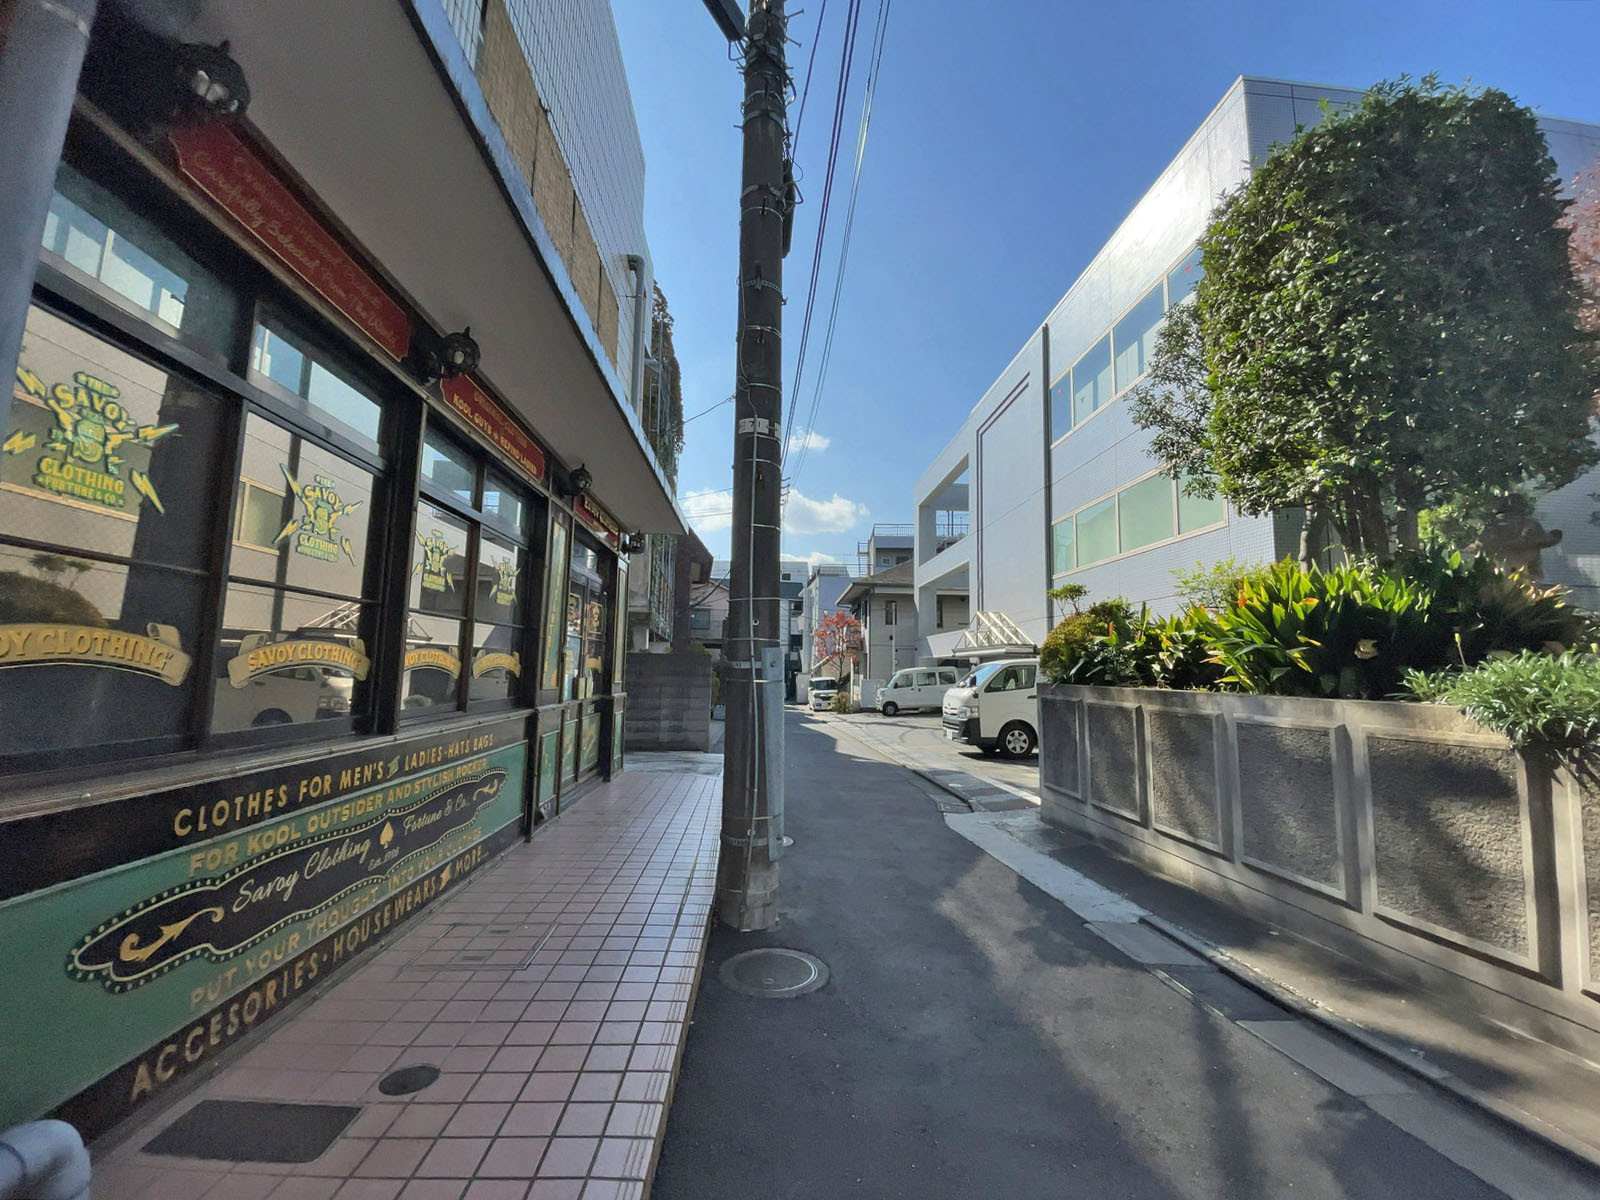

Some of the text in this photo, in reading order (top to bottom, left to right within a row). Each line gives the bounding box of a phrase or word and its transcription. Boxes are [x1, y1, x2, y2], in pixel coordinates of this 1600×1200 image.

[54, 385, 130, 431] SAVOY
[453, 393, 473, 419] KOOL
[40, 456, 125, 496] CLOTHING
[303, 486, 342, 511] SAVOY
[299, 533, 339, 554] CLOTHING
[247, 643, 361, 672] SAVOY CLOTHING
[173, 784, 288, 837] CLOTHES
[298, 774, 332, 802] FOR
[339, 760, 384, 792] MEN'S
[473, 733, 493, 752] BAGS
[188, 841, 240, 879] FOR
[247, 822, 301, 854] KOOL
[307, 792, 384, 834] OUTSIDER
[386, 784, 412, 804] AND
[413, 769, 454, 795] STYLISH
[232, 870, 300, 912] Savoy
[304, 838, 371, 880] Clothing
[402, 808, 443, 836] Fortune
[189, 967, 238, 1010] PUT
[245, 932, 300, 972] YOUR
[306, 886, 379, 940] THOUGHT
[131, 951, 319, 1101] ACCESORIES
[332, 875, 437, 963] HOUSEWEARS
